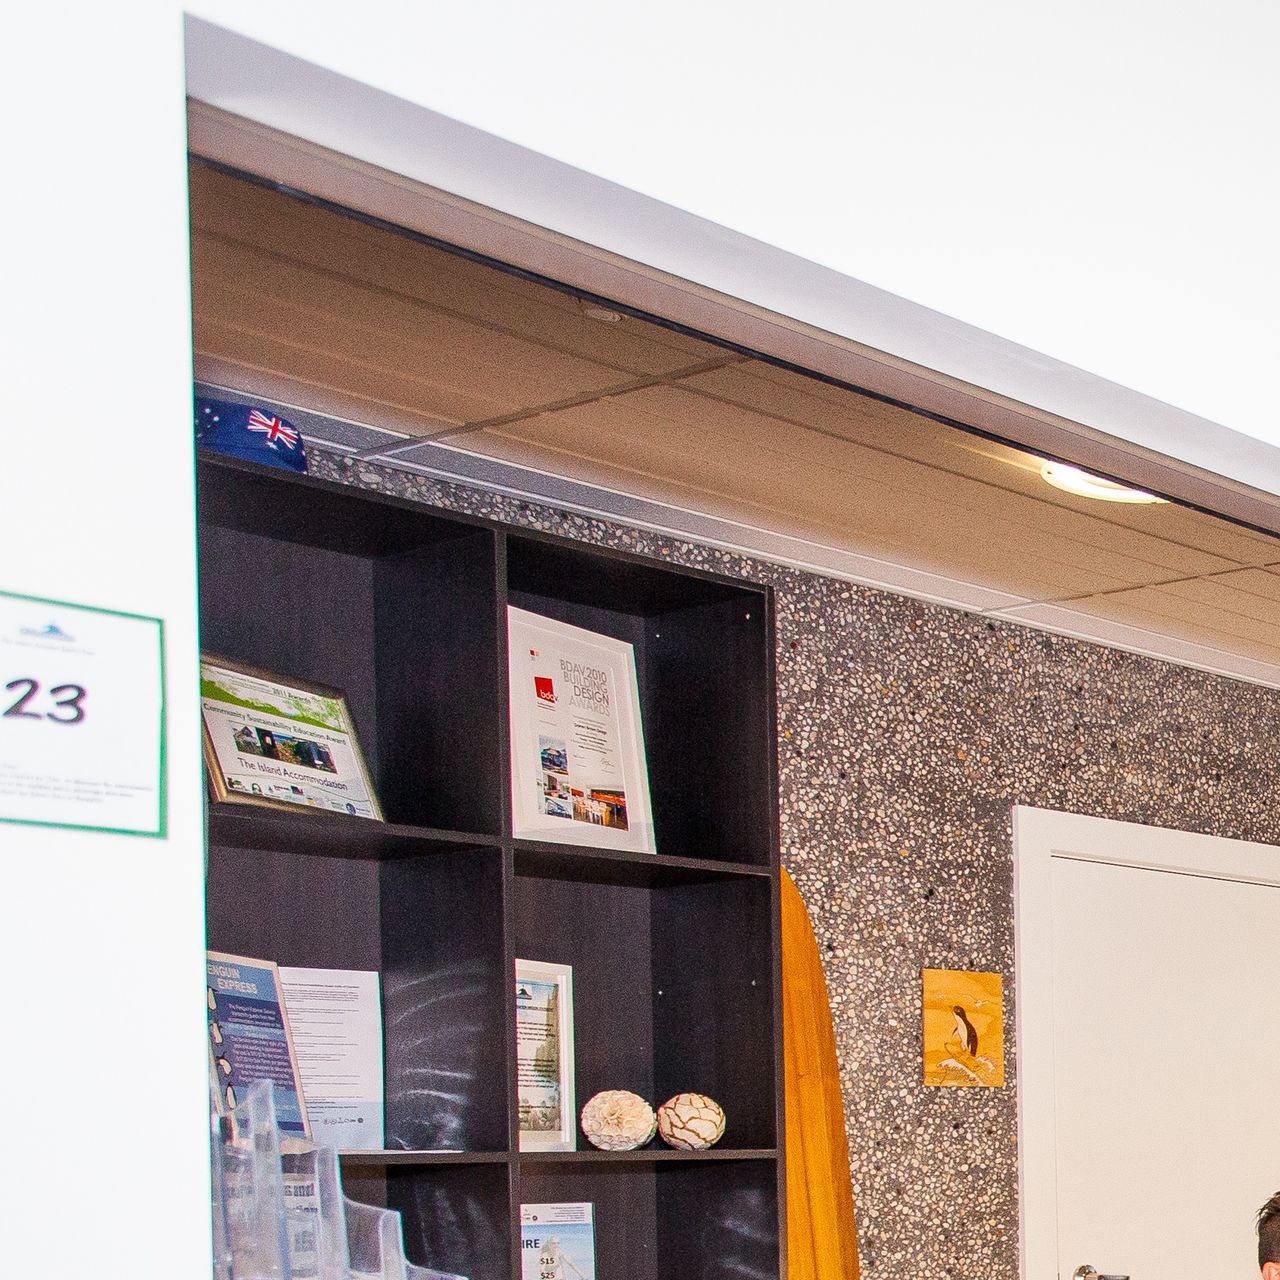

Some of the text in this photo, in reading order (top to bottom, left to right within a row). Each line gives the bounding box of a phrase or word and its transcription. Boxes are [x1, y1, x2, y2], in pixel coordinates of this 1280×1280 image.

[563, 671, 608, 694] BUILDING
[3, 677, 87, 725] 23
[271, 686, 312, 705] 2011 Awards
[573, 685, 610, 706] DESIGN
[568, 696, 611, 717] AWARDS
[203, 702, 347, 746] Community Sustainability Education Award
[238, 757, 348, 791] The Island Accommodation
[208, 964, 240, 978] ENGUIN
[217, 978, 258, 994] EXPRESS
[522, 1239, 540, 1249] IRE
[540, 1257, 555, 1265] $15
[540, 1271, 556, 1280] $25
